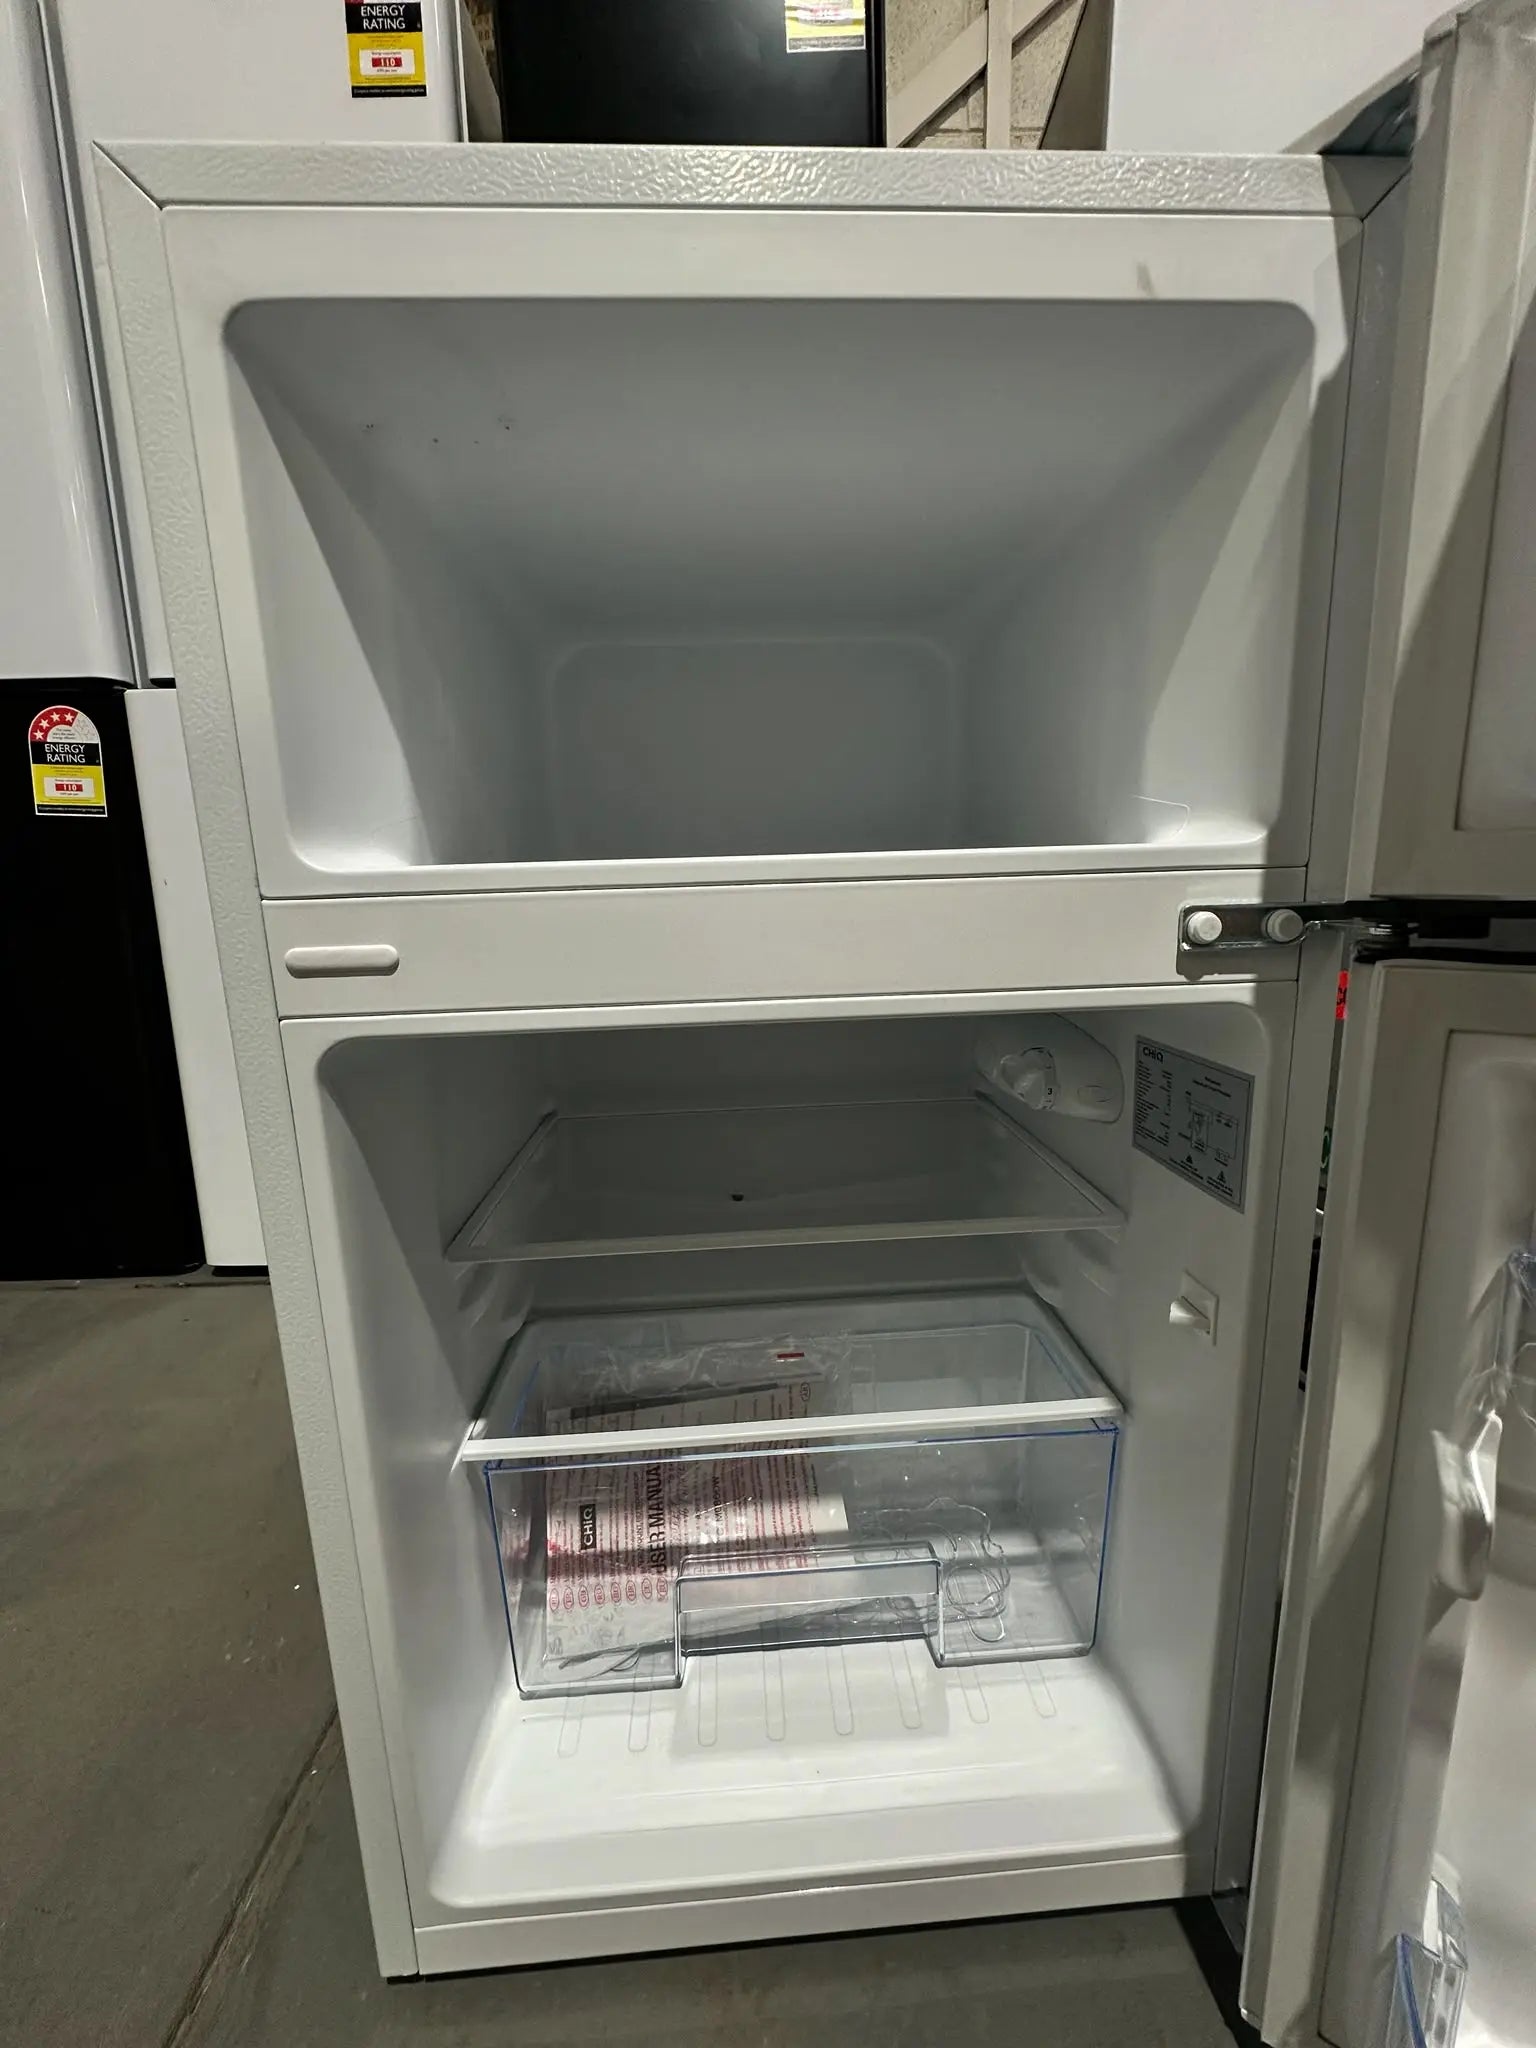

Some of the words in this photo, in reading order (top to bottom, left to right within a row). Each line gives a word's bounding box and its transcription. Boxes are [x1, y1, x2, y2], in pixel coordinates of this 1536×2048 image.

[361, 5, 406, 17] ENERGY
[363, 17, 406, 30] RATING
[380, 58, 396, 67] 110
[44, 743, 86, 754] ENERGY
[46, 753, 86, 764] RATING
[645, 1463, 666, 1529] MANUA
[583, 1505, 594, 1546] CHiQ
